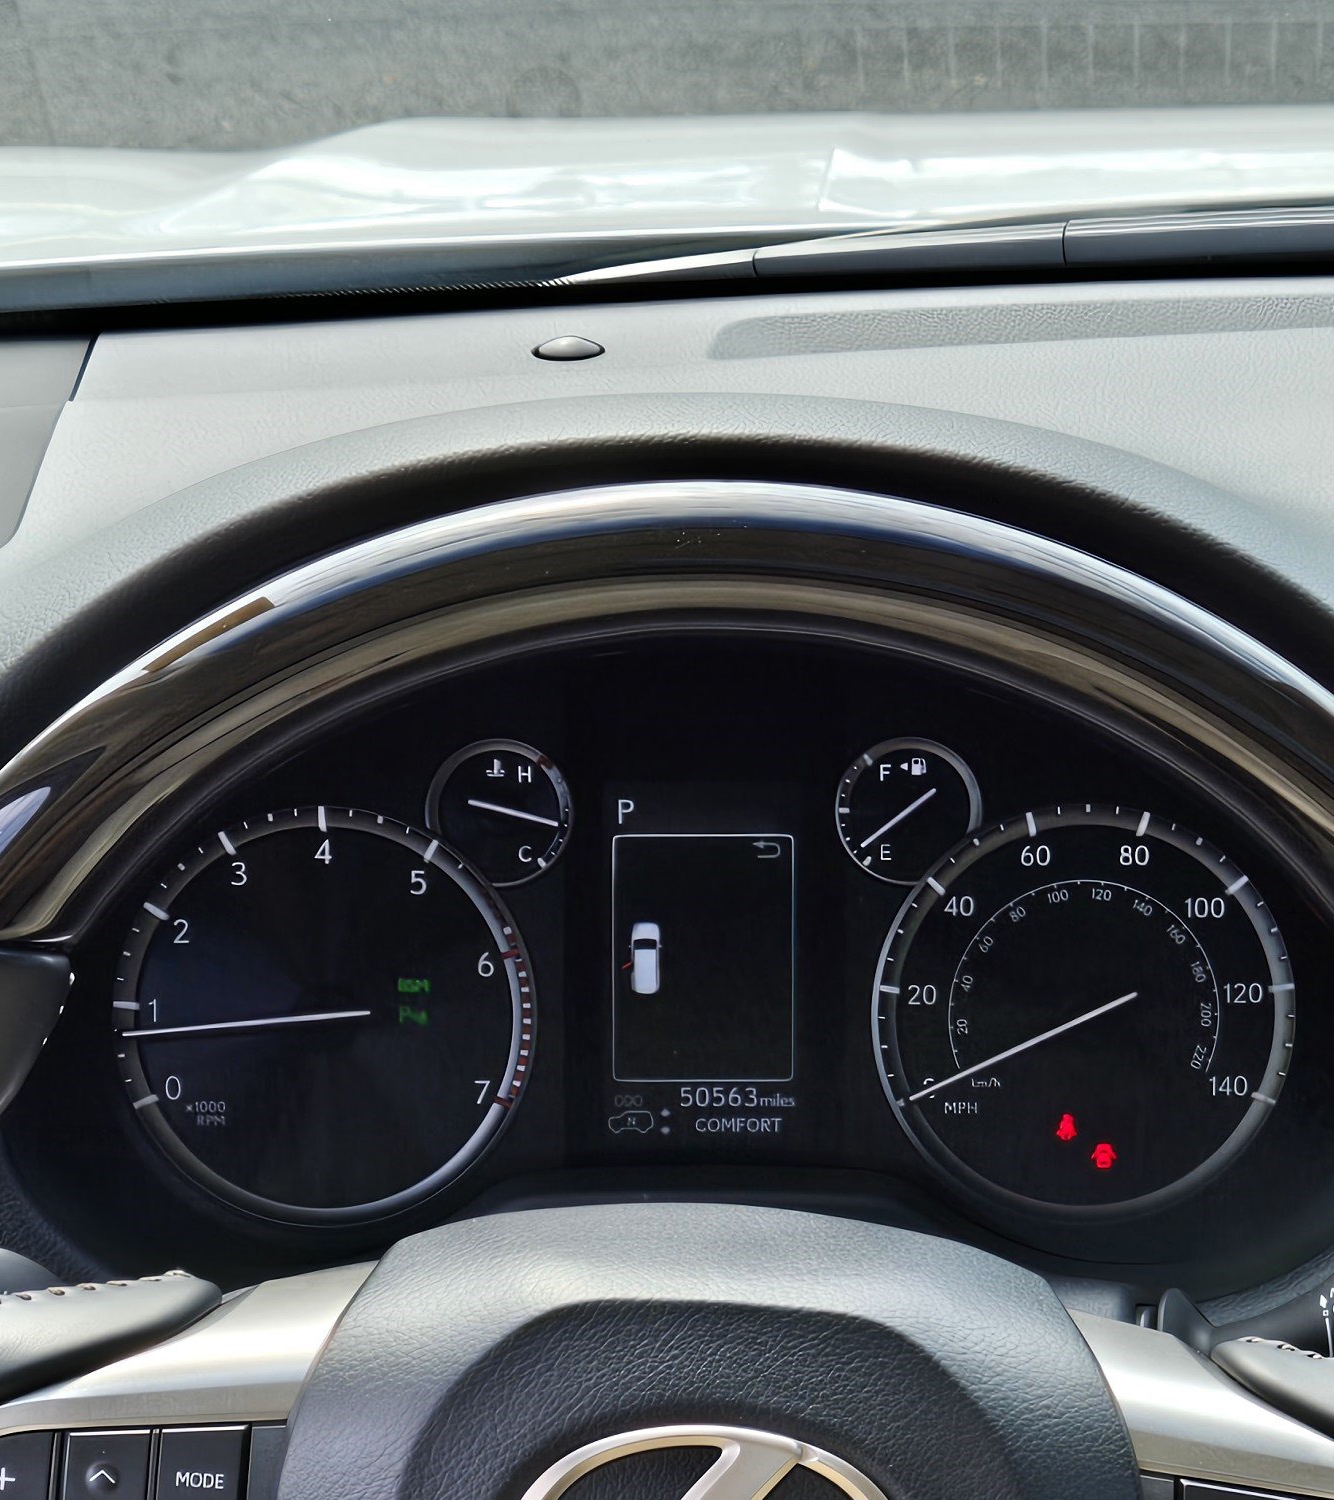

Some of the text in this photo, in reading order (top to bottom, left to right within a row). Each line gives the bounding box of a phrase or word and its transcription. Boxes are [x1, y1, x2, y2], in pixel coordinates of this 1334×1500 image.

[517, 765, 532, 783] H
[879, 763, 892, 782] F
[617, 799, 635, 825] P
[314, 838, 333, 865] 4
[518, 845, 533, 863] C
[880, 843, 892, 861] E
[1020, 844, 1051, 867] 60
[1119, 844, 1150, 866] 80
[230, 861, 248, 886] 3
[410, 869, 427, 896] 5
[1047, 889, 1069, 904] 100
[1091, 887, 1112, 902] 120
[943, 896, 976, 918] 40
[1008, 903, 1026, 922] 80
[1132, 900, 1153, 917] 140
[1184, 897, 1227, 919] 100
[173, 918, 190, 944] 2
[1166, 922, 1187, 945] 160
[976, 933, 994, 953] 60
[477, 951, 495, 978] 6
[1190, 958, 1208, 983] 180
[907, 984, 937, 1005] 20
[960, 975, 974, 992] 40
[1223, 982, 1263, 1004] 120
[148, 998, 157, 1023] 1
[1200, 1002, 1212, 1027] 200
[956, 1018, 969, 1035] 20
[1190, 1045, 1207, 1069] 220
[165, 1075, 182, 1101] 0
[473, 1079, 491, 1105] 7
[680, 1086, 796, 1107] 50563 miles
[1209, 1075, 1248, 1096] 140
[943, 1101, 979, 1114] MPH
[695, 1117, 783, 1133] COMFORT
[175, 1471, 225, 1490] MODE
